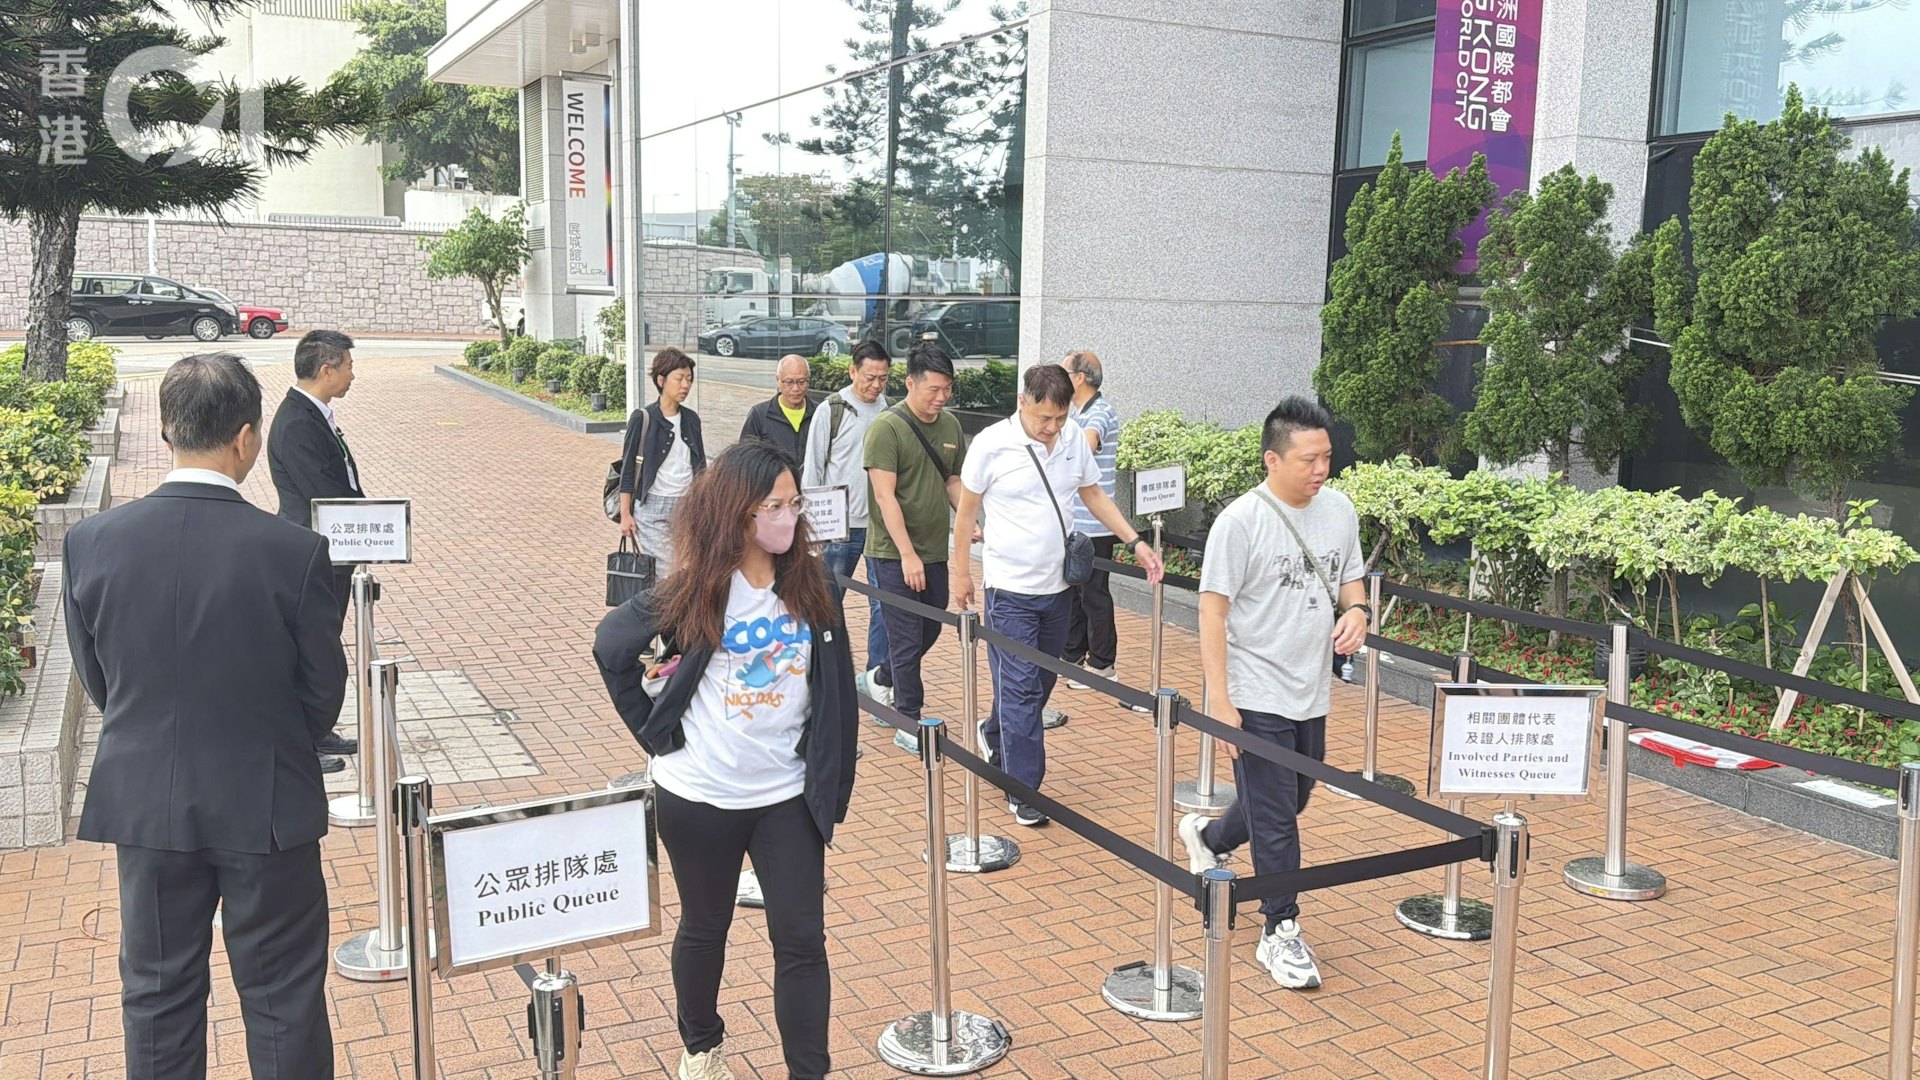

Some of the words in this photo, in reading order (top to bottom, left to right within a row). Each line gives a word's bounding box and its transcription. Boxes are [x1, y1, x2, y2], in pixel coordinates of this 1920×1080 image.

[1467, 19, 1493, 131] KONG
[1454, 71, 1469, 128] CITY
[567, 92, 586, 199] WELCOME
[1158, 493, 1175, 501] Queue
[330, 522, 394, 534] 公眾排隊處
[332, 538, 361, 546] Public
[364, 538, 394, 548] Queue
[1467, 712, 1556, 726] 相關團體代表
[1465, 732, 1554, 746] 及證人排隊處
[1448, 751, 1499, 762] Involved
[1503, 753, 1544, 763] Parties
[1547, 753, 1569, 763] and
[1458, 768, 1515, 779] Witnesses
[1519, 770, 1557, 780] Queue
[474, 850, 619, 899] 公眾排隊處
[477, 901, 546, 927] Public
[553, 888, 620, 913] Queue
